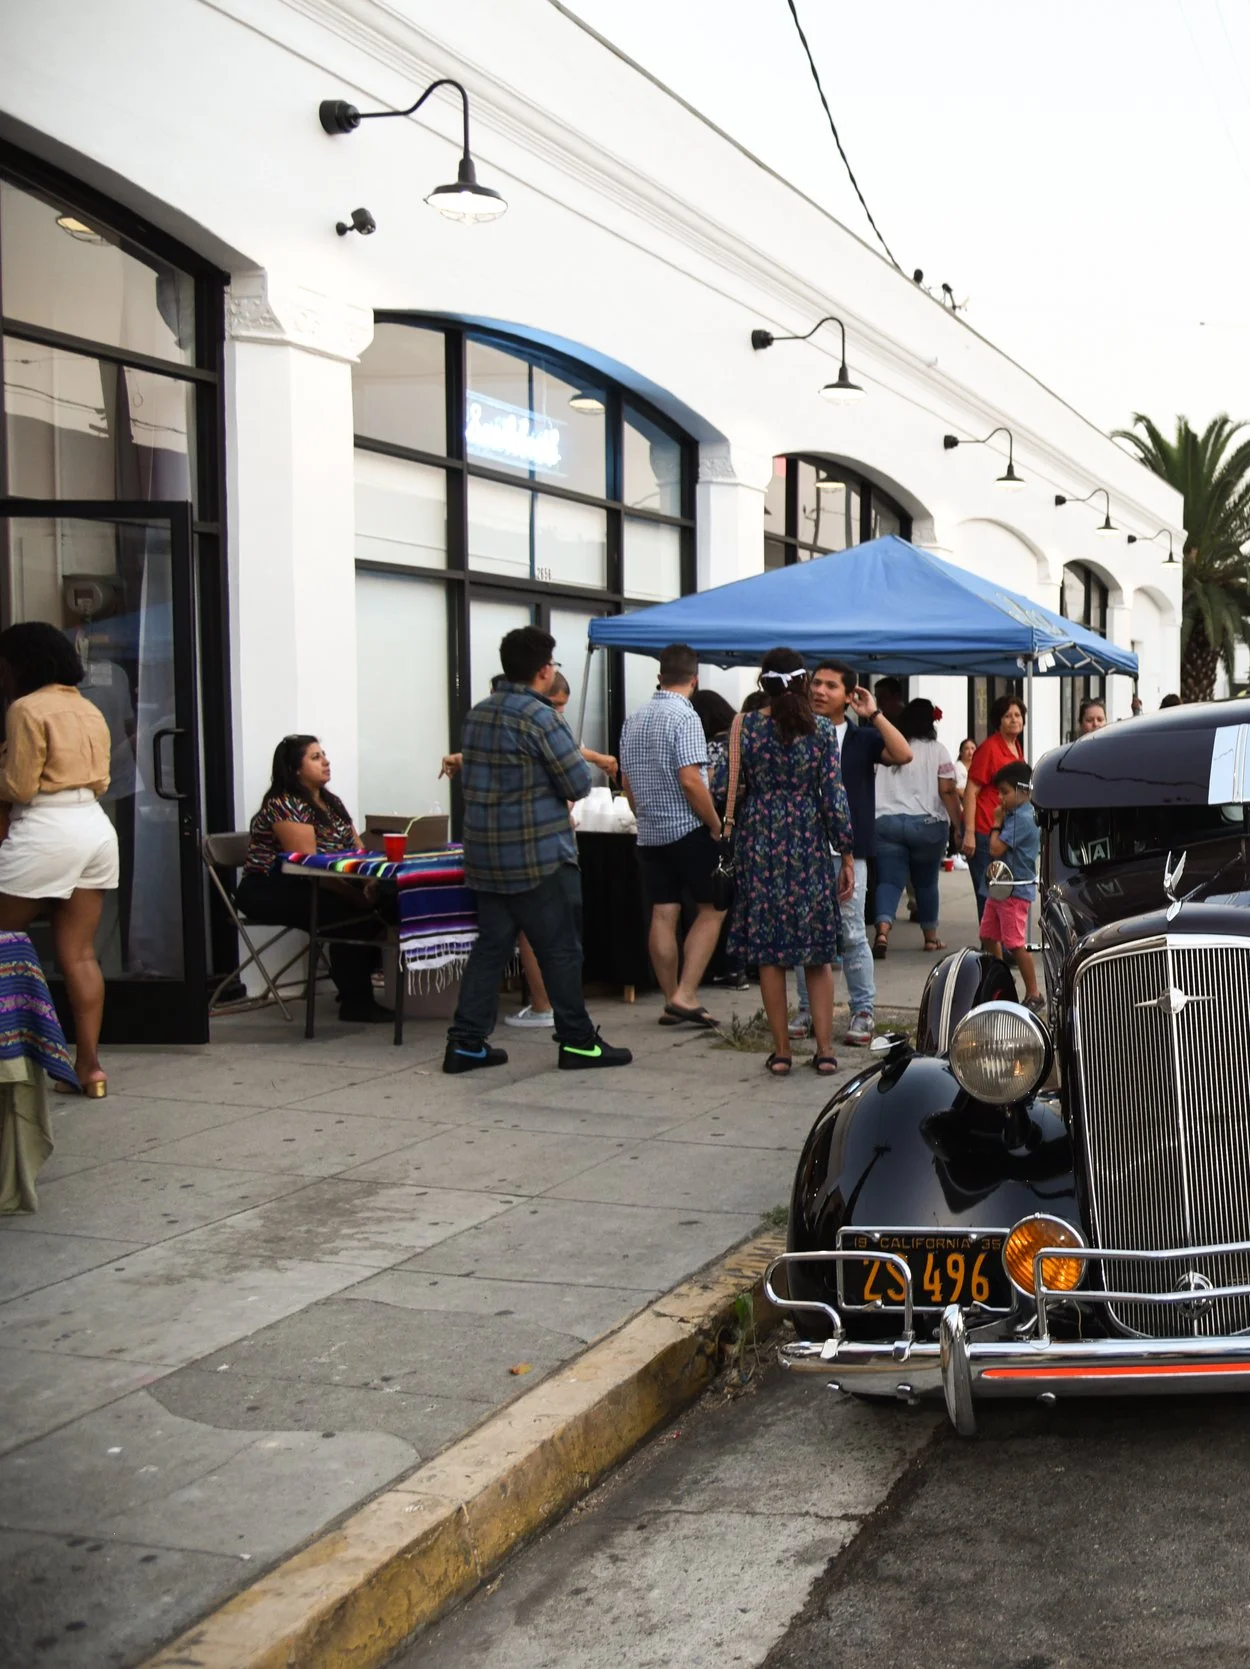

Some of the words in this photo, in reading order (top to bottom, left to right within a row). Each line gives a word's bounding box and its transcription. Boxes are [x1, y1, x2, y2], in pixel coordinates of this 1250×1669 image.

[1092, 844, 1107, 861] A
[880, 1237, 971, 1249] CALIFORNIA
[981, 1237, 1001, 1249] 35
[923, 1252, 990, 1302] 496
